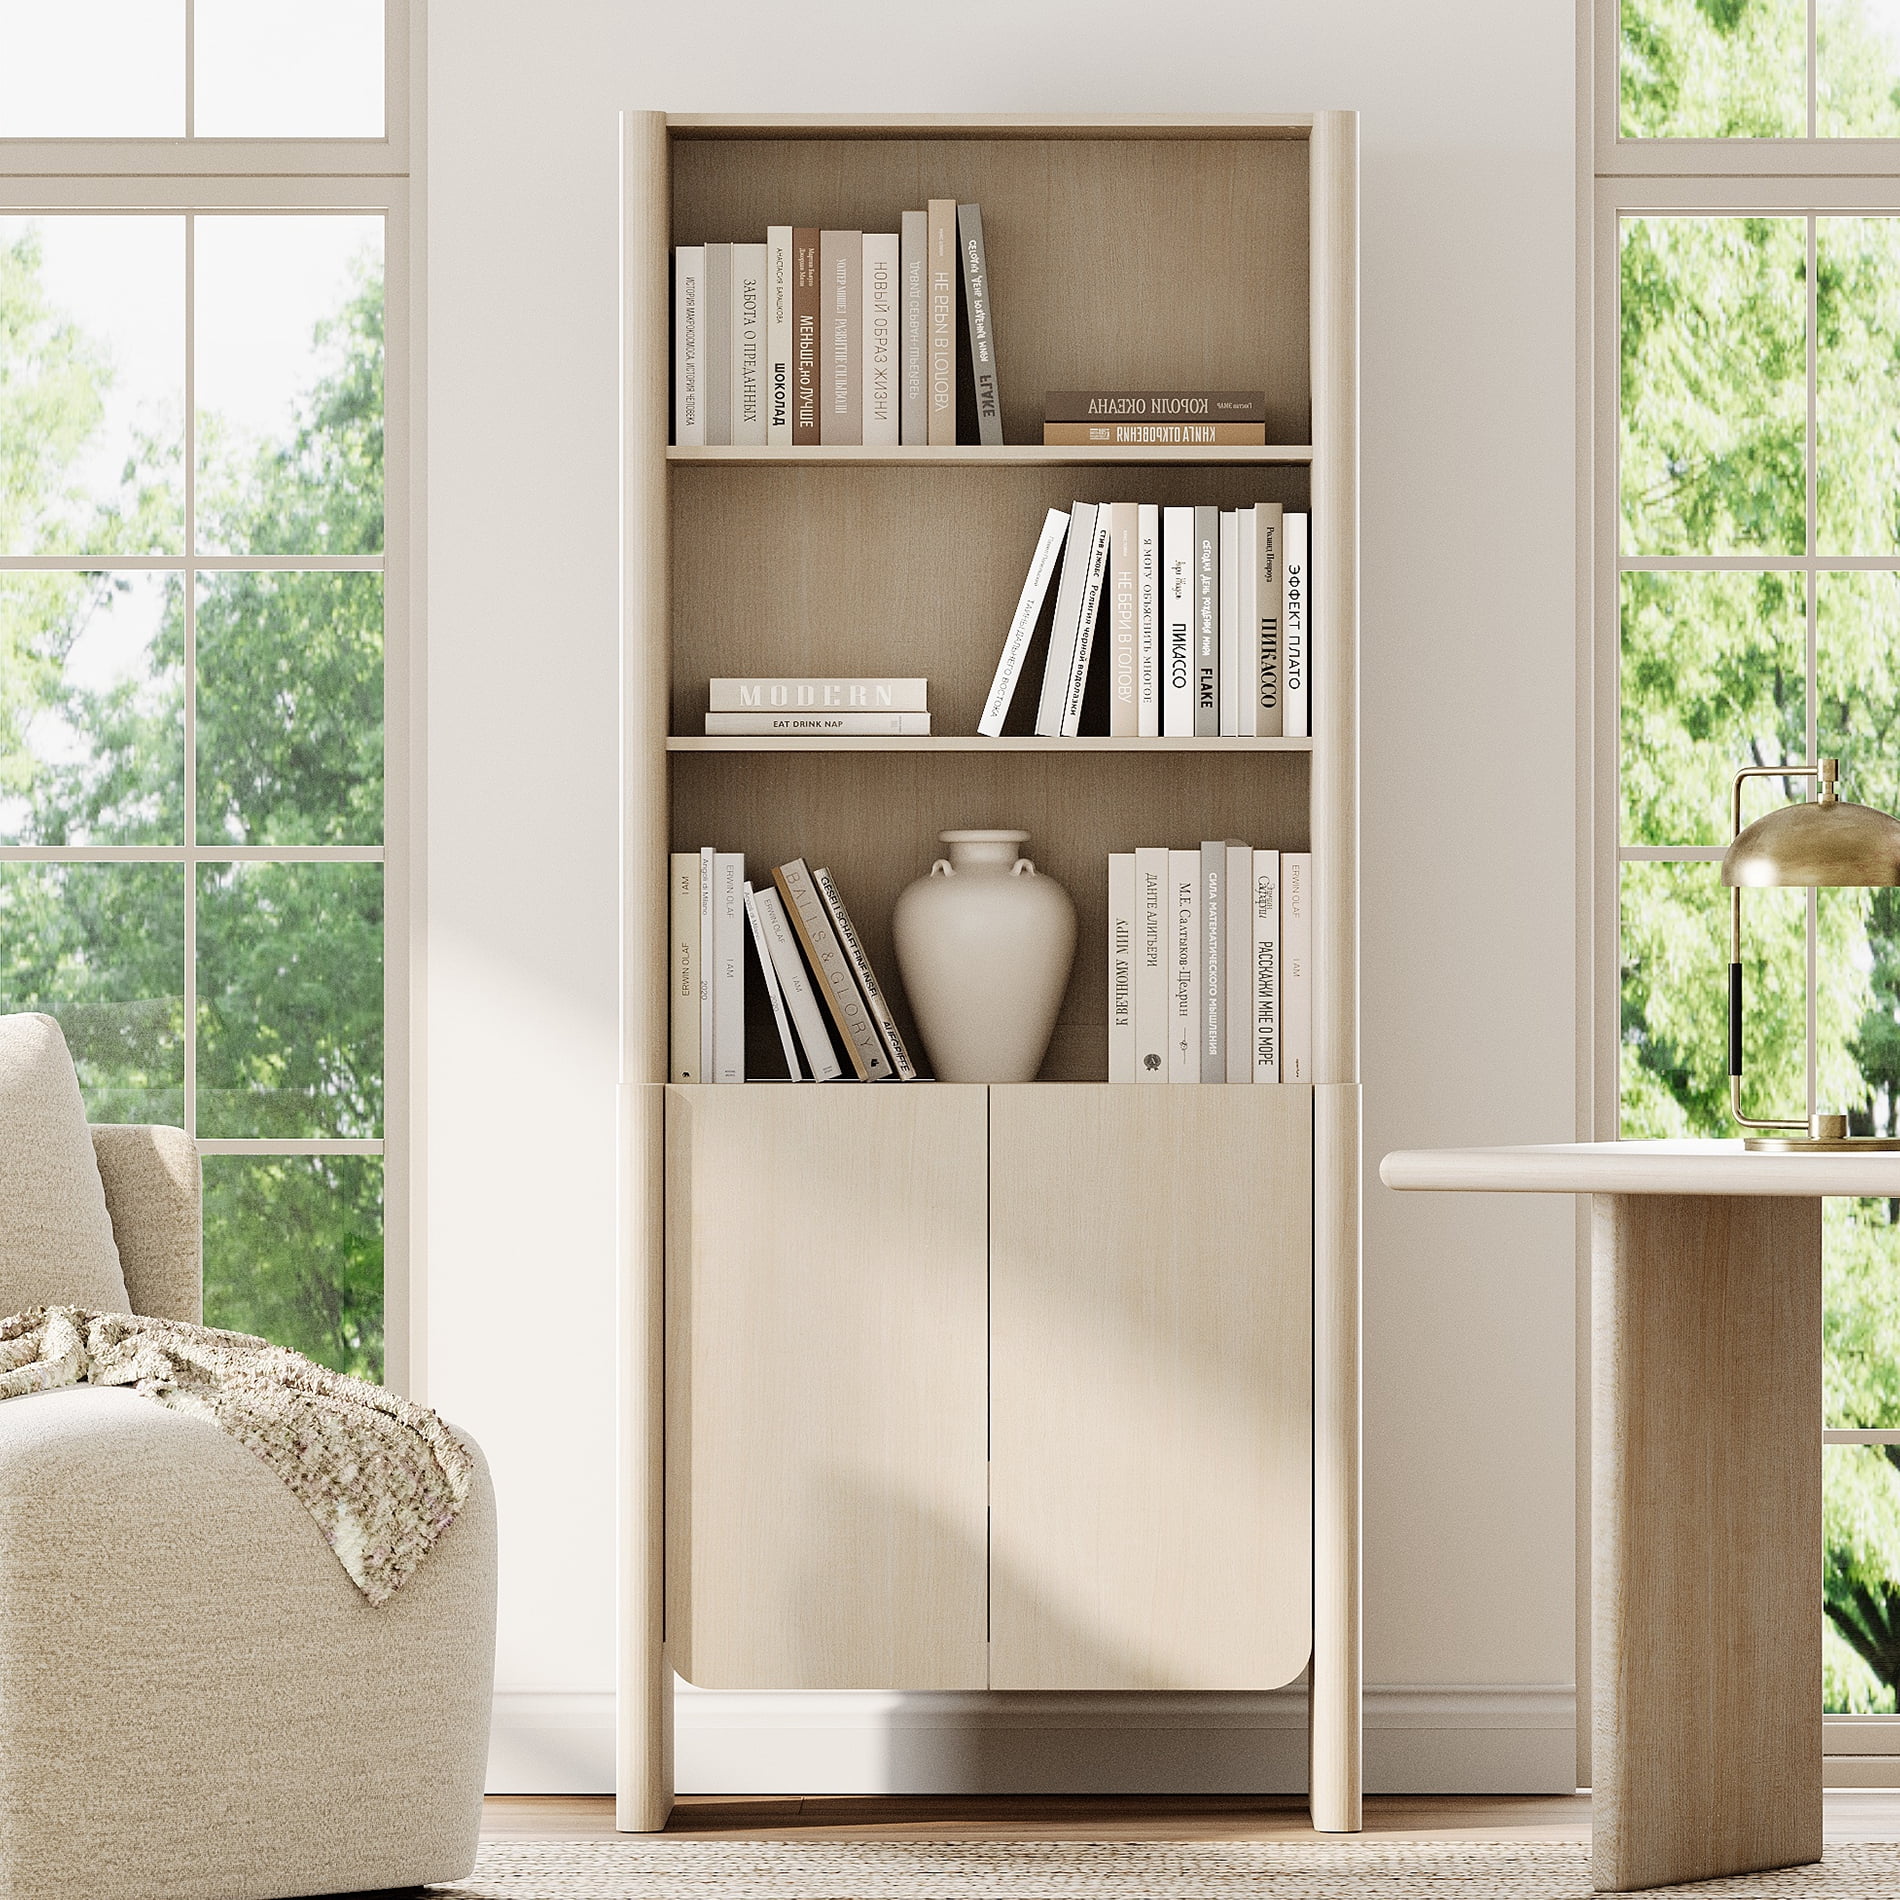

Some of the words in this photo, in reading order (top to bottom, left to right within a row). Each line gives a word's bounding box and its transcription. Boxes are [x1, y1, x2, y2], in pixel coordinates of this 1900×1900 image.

[686, 277, 695, 306] ИСТОРИЯ
[744, 279, 756, 326] ЗАБОТА
[874, 262, 890, 313] НОВЫЙ
[744, 330, 756, 340] О
[835, 318, 848, 364] РАЗВИТИЕ
[874, 318, 888, 362] ОБРАЗ
[686, 363, 695, 392] ИСТОРИЯ
[742, 344, 756, 422] ПРЕДАННЫХ
[773, 363, 786, 426] ШОКОЛАД
[874, 368, 888, 420] ЖИЗНИ
[686, 394, 695, 426] ЧЕЛОВЕКА
[800, 386, 813, 428] ЛУЧШЕ
[1144, 550, 1152, 580] МОГУ
[1202, 540, 1212, 572] СЕГОДНЯ
[1118, 572, 1132, 590] НЕ
[1200, 574, 1211, 595] ДЕНЬ
[1288, 565, 1300, 630] ЭФФЕКТ
[1086, 585, 1098, 624] Религия
[1118, 594, 1132, 630] БЕРИ
[1144, 584, 1152, 652] ОБЪЯСНИТЬ
[1201, 597, 1212, 634] РОЖДЕНИЯ
[1004, 630, 1025, 678] ДАЛЬНЕГО
[1079, 627, 1090, 662] черной
[1118, 634, 1132, 642] В
[1172, 624, 1186, 688] ПИКАССО
[1202, 636, 1211, 656] МИРА
[1118, 648, 1132, 704] ГОЛОВУ
[1144, 656, 1152, 703] МНОГОЕ
[1260, 618, 1277, 708] ПИКАССО
[1288, 636, 1300, 689] ПЛАТО
[740, 684, 893, 706] MODERN
[990, 677, 1010, 718] ВОСТОКА
[1070, 664, 1084, 716] водолазки
[1200, 668, 1212, 708] FLAKE
[682, 876, 688, 890] AM
[1145, 872, 1158, 908] ДАНТЕ
[1209, 872, 1218, 899] СИЛА
[764, 898, 778, 924] ERWIN
[773, 924, 786, 944] OLAF
[1116, 918, 1128, 954] МИРУ
[1147, 911, 1158, 967] АЛИГЬЕРИ
[786, 872, 826, 943] BALLS
[822, 952, 834, 962] &
[830, 972, 874, 1050] GLORY
[1209, 902, 1218, 996] МАТЕМАТИЧЕСКОГО
[1258, 942, 1274, 997] РАССКАЖИ
[727, 964, 734, 978] AM
[1116, 959, 1128, 1015] ВЕЧНОМУ
[1293, 964, 1300, 977] AM
[1209, 998, 1218, 1055] МЫШЛЕНИЯ
[1258, 1001, 1274, 1023] МНЕ
[1258, 1037, 1274, 1066] МОРЕ
